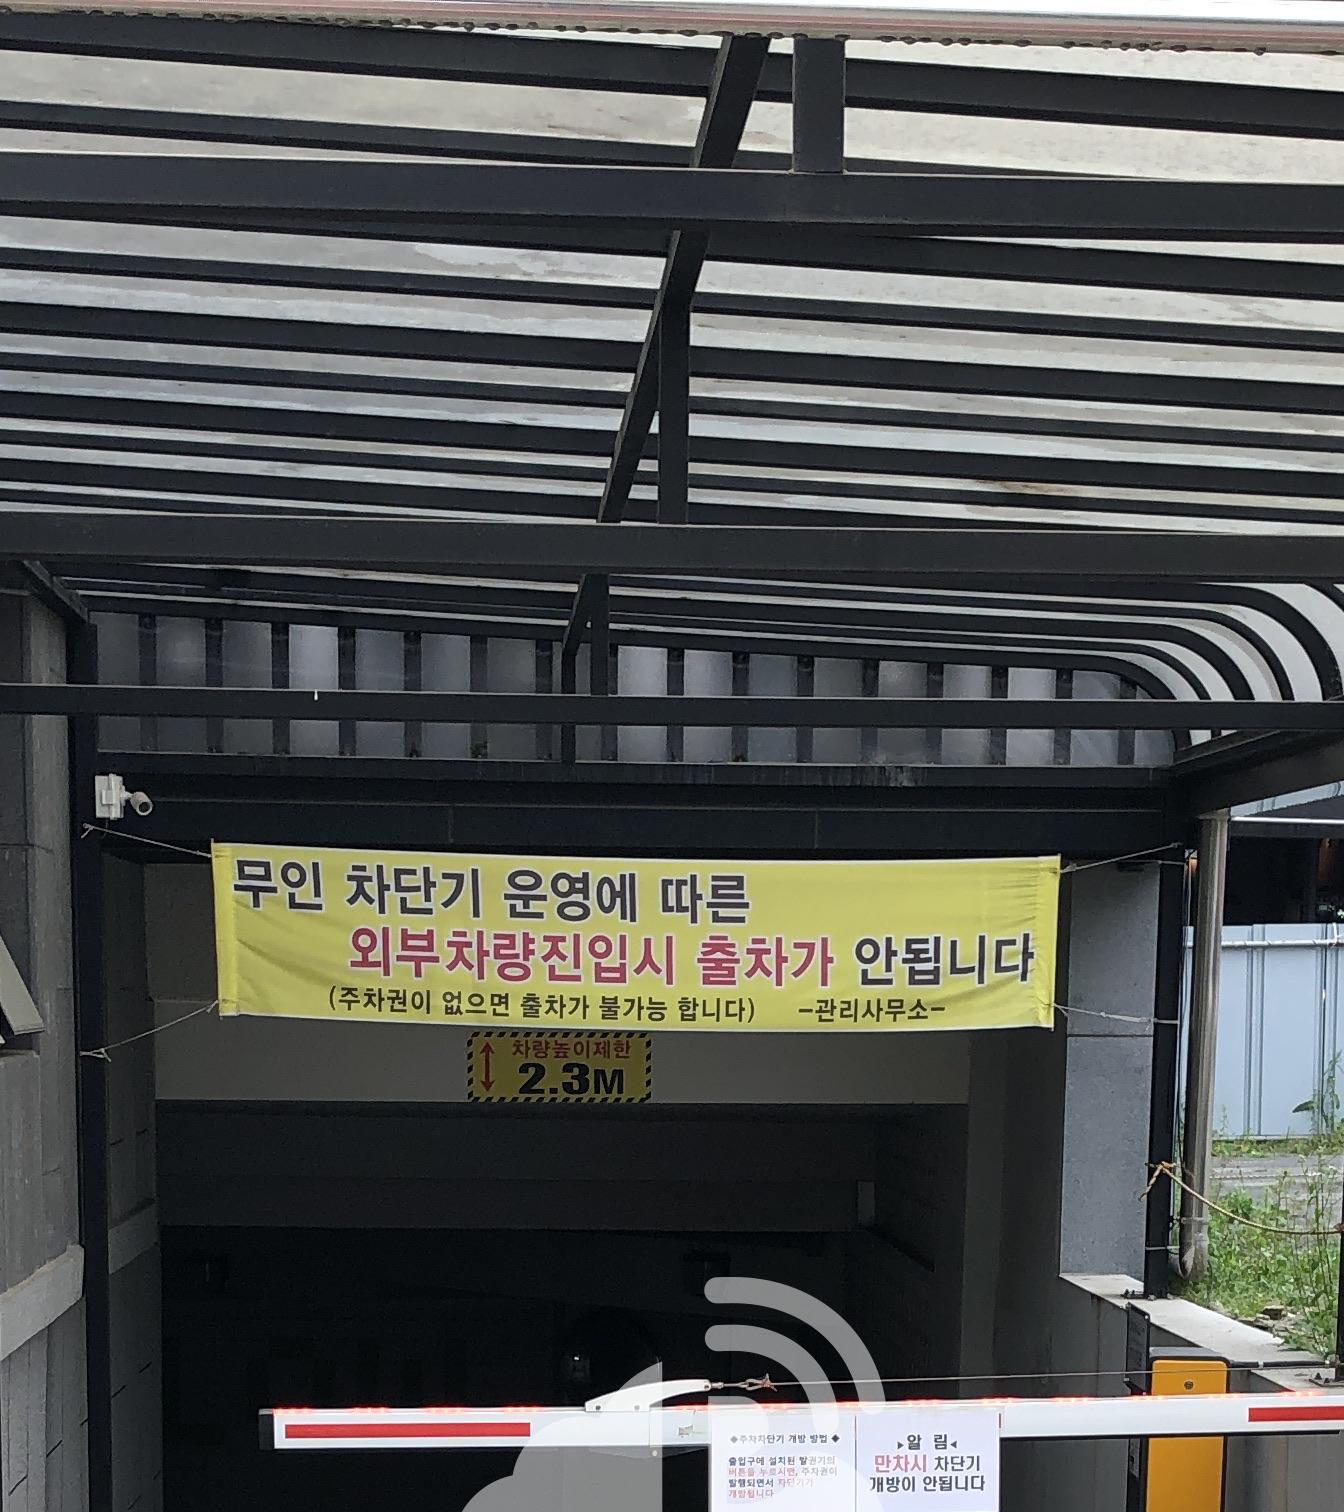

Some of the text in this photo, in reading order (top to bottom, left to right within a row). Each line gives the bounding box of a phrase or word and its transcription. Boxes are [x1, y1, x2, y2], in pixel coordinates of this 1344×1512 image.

[233, 859, 750, 924] 무인 차단기 운영에 따른
[350, 926, 1035, 987] 외부차량진입시 출차가 안됩니다
[329, 985, 946, 1023] (주차권이 없으면 출차가 불가능 합니다) -관리사무소-
[512, 1039, 632, 1060] 차량높이제한
[518, 1062, 625, 1095] 2.3M
[788, 1434, 806, 1444] 개방
[810, 1434, 828, 1444] 방법
[906, 1433, 949, 1451] 알 림
[728, 1456, 765, 1467] 출입구에
[769, 1456, 796, 1466] 설치된
[874, 1454, 981, 1474] 만차시 차단기
[728, 1478, 774, 1488] 발행되면서
[869, 1474, 986, 1494] 개방이 안됩니다
